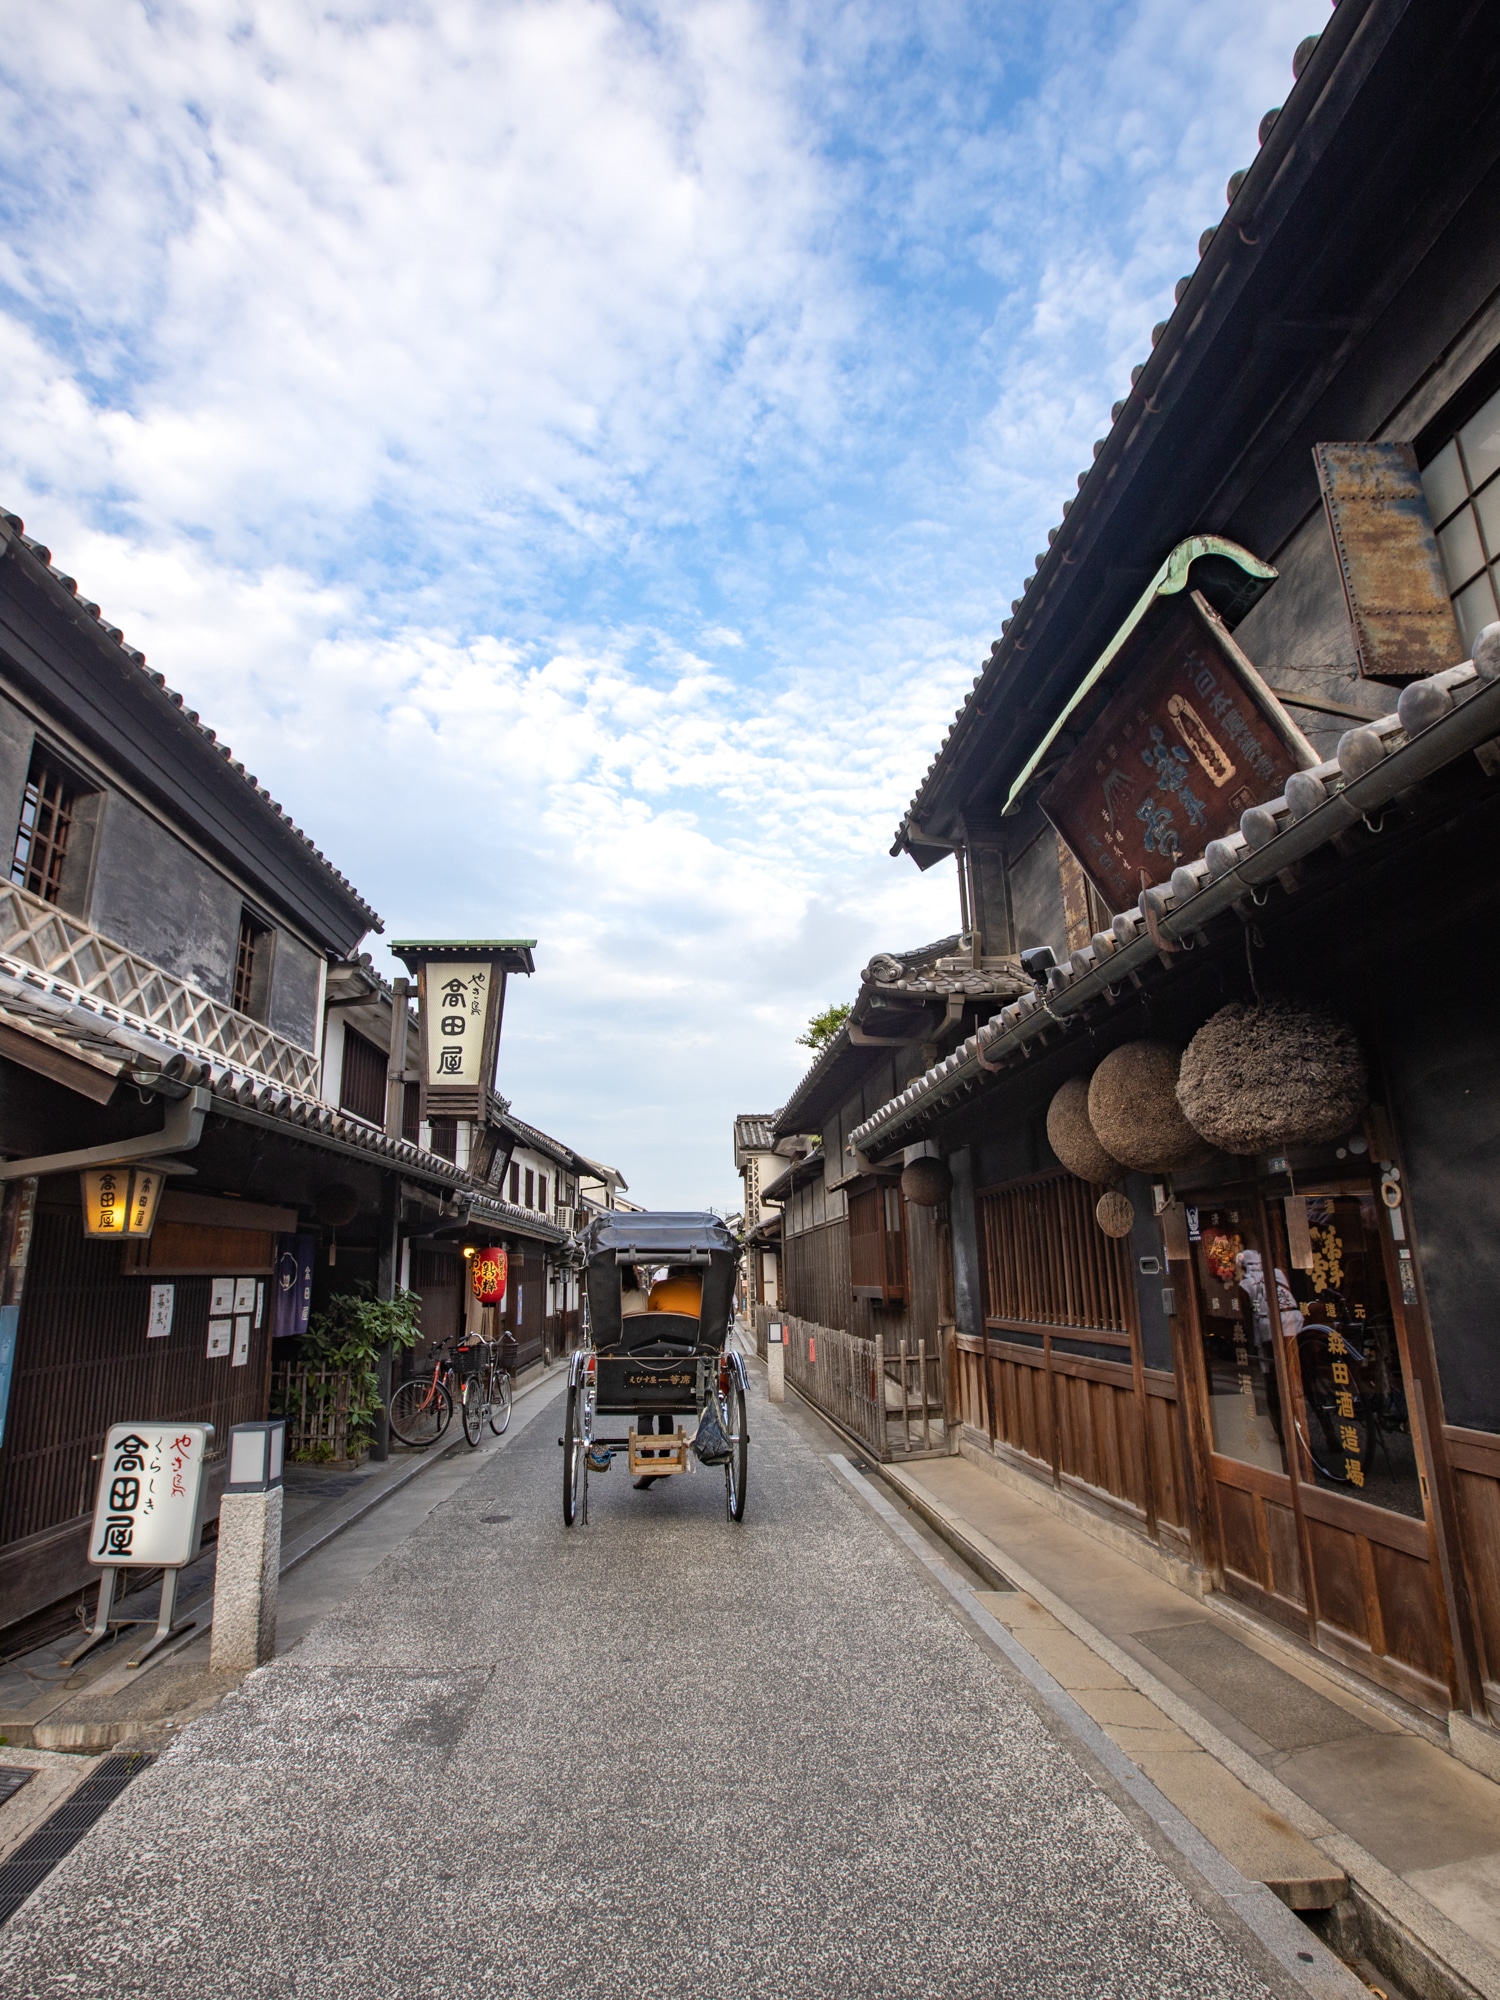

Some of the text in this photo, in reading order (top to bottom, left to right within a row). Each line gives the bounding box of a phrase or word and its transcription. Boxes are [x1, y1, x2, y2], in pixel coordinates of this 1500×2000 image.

[629, 1374, 691, 1385] えびす屋 一等席
[1327, 1330, 1365, 1488] 森田酒造場
[143, 1436, 163, 1515] くらしき
